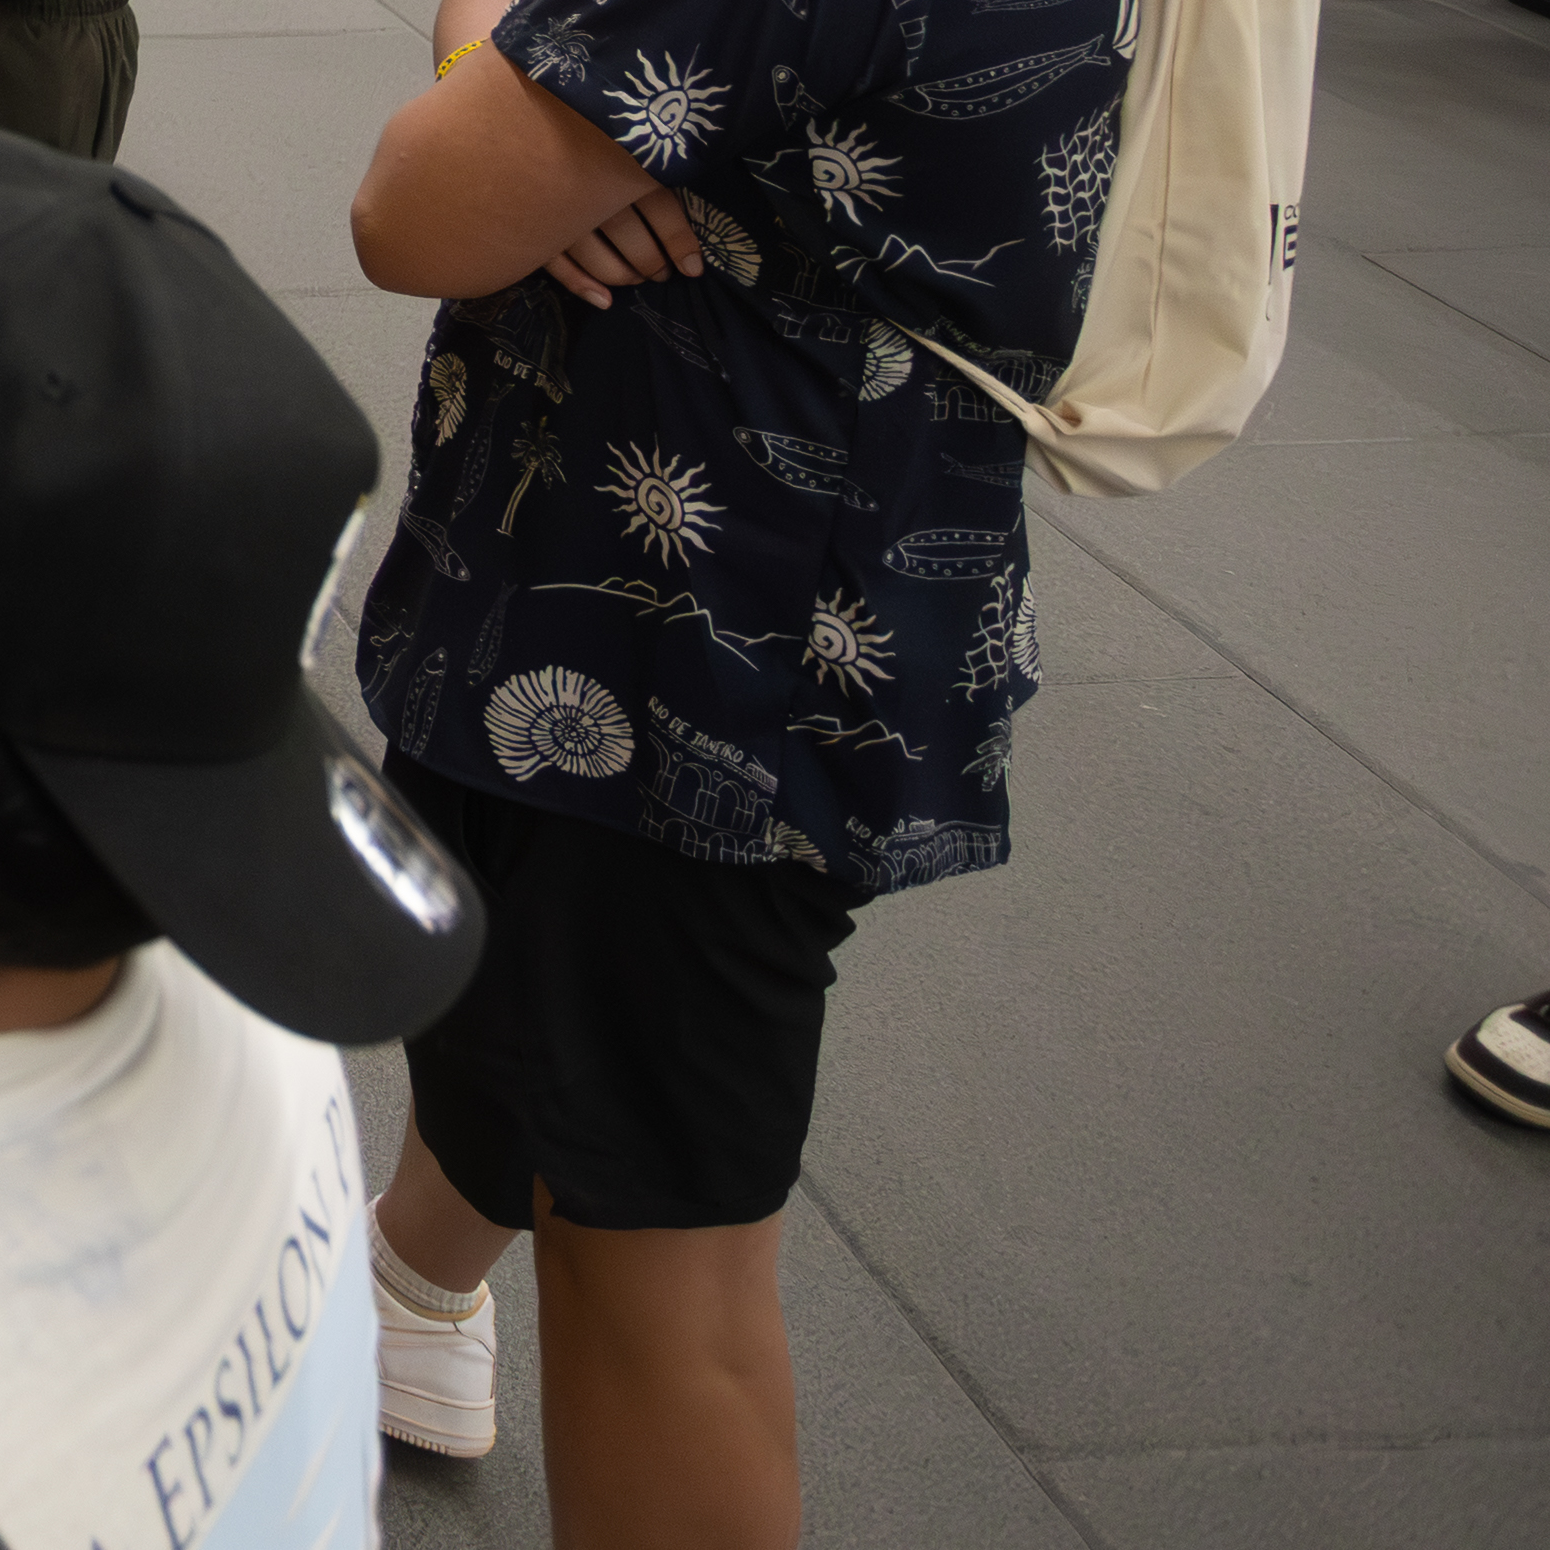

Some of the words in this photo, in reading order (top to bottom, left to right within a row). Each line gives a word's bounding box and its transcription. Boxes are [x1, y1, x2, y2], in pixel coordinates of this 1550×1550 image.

[494, 349, 513, 370] RIO
[513, 361, 533, 380] DE
[647, 696, 669, 719] RIO
[668, 716, 692, 735] DE
[690, 731, 744, 763] JANEIRO
[846, 816, 872, 839] RIO
[142, 1166, 334, 1550] EPSILON
